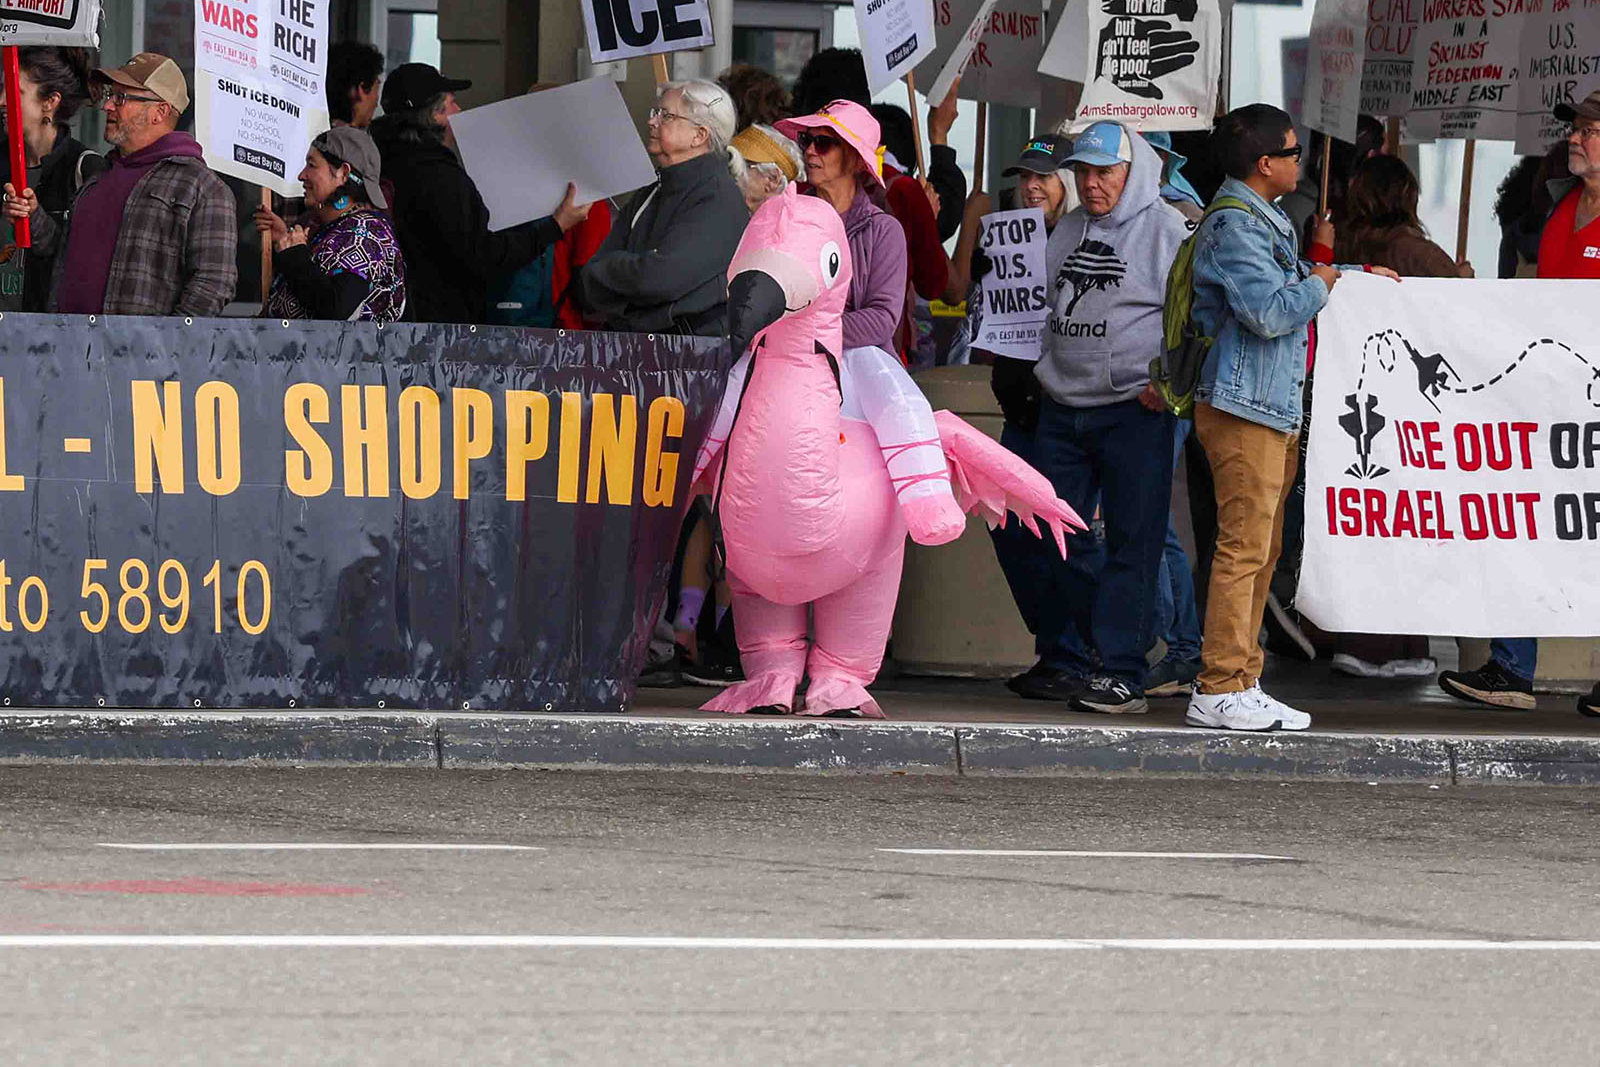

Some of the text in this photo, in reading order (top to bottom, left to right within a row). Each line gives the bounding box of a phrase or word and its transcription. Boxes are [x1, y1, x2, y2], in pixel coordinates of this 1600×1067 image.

[1115, 18, 1136, 36] but
[1453, 20, 1488, 38] IN A
[1550, 23, 1577, 49] U.S.
[274, 22, 316, 64] RICH
[1126, 37, 1150, 55] feel
[1428, 41, 1489, 69] SOCIALIST
[1119, 58, 1151, 78] poor.
[1427, 64, 1503, 85] FEDERATION
[218, 79, 300, 118] SHUT ICE DOWN
[1412, 84, 1511, 107] MIDDLE EAST
[245, 107, 279, 124] NO WORK
[1080, 103, 1198, 119] ArmsEmbargoNow.org
[238, 129, 249, 140] NO
[240, 118, 252, 129] NO
[247, 153, 283, 173] East Bay DSA
[984, 218, 1037, 247] STOP
[994, 254, 1032, 279] U.S.
[987, 286, 1046, 314] WARS
[1000, 330, 1014, 340] EAST
[1050, 318, 1107, 337] akland
[132, 380, 241, 495] NO
[285, 382, 686, 507] SHOPPING
[1394, 419, 1446, 471] ICE
[1453, 422, 1539, 472] OUT
[1326, 486, 1454, 539] ISRAEL
[1458, 492, 1541, 541] OUT
[80, 558, 273, 635] 58910
